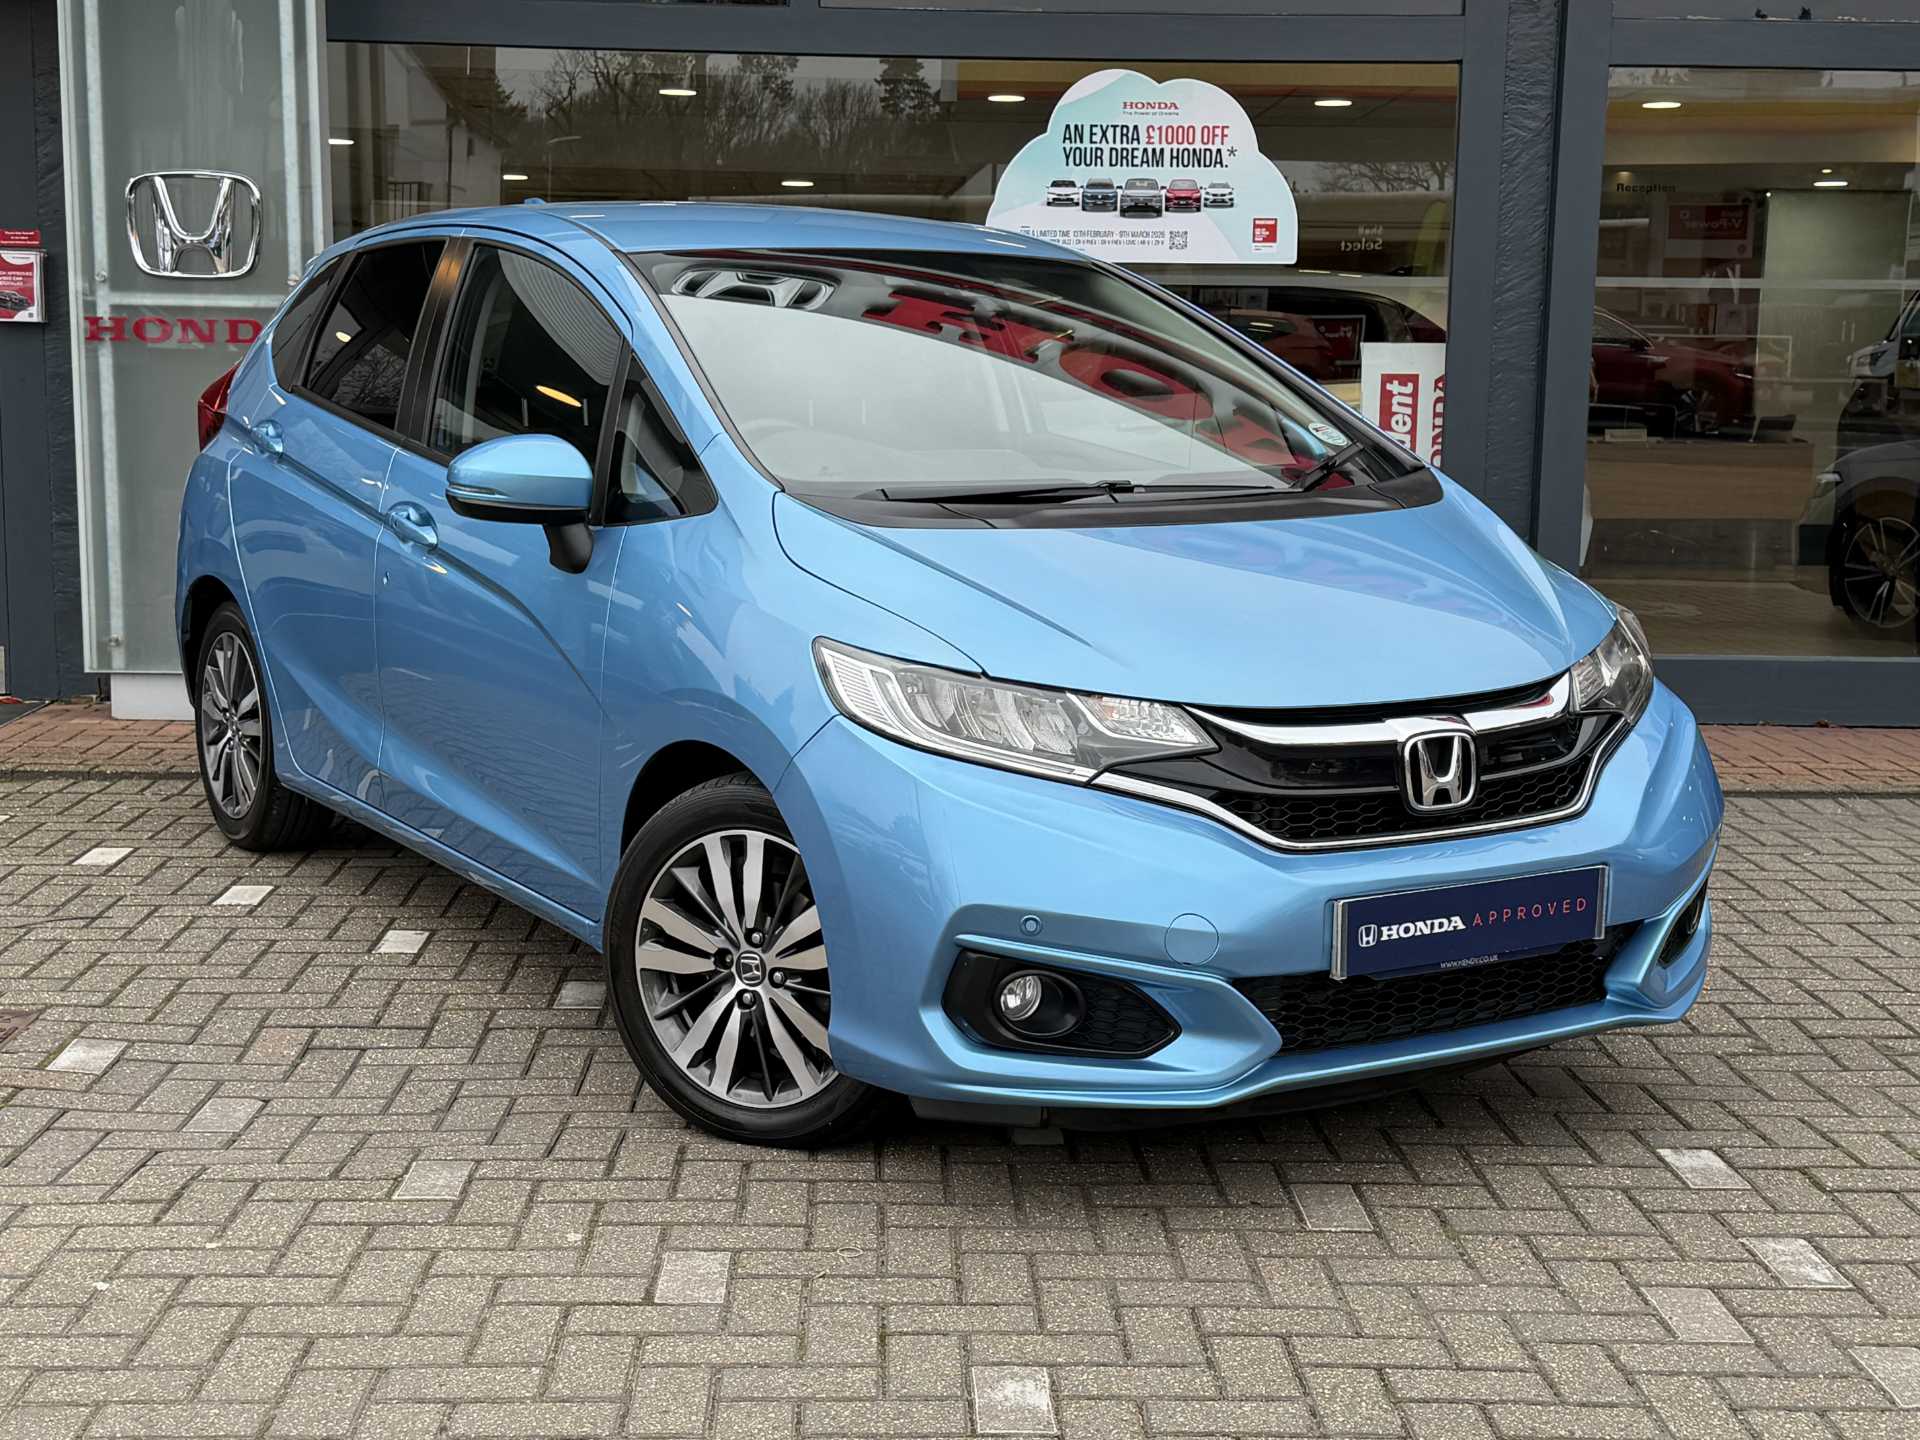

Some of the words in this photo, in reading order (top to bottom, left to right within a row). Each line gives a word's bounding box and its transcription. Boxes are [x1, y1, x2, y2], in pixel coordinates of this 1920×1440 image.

[1122, 101, 1179, 110] HONDA
[1063, 124, 1084, 145] AN
[1089, 124, 1141, 145] EXTRA
[1146, 125, 1196, 146] £1000
[1201, 125, 1230, 146] OFF
[1063, 147, 1104, 167] YOUR
[1108, 147, 1165, 168] DREAM
[1616, 183, 1676, 194] Reception
[84, 316, 263, 344] HOND
[1385, 380, 1414, 449] dent
[1380, 916, 1467, 942] HONDA
[1473, 897, 1588, 927] APPROVED
